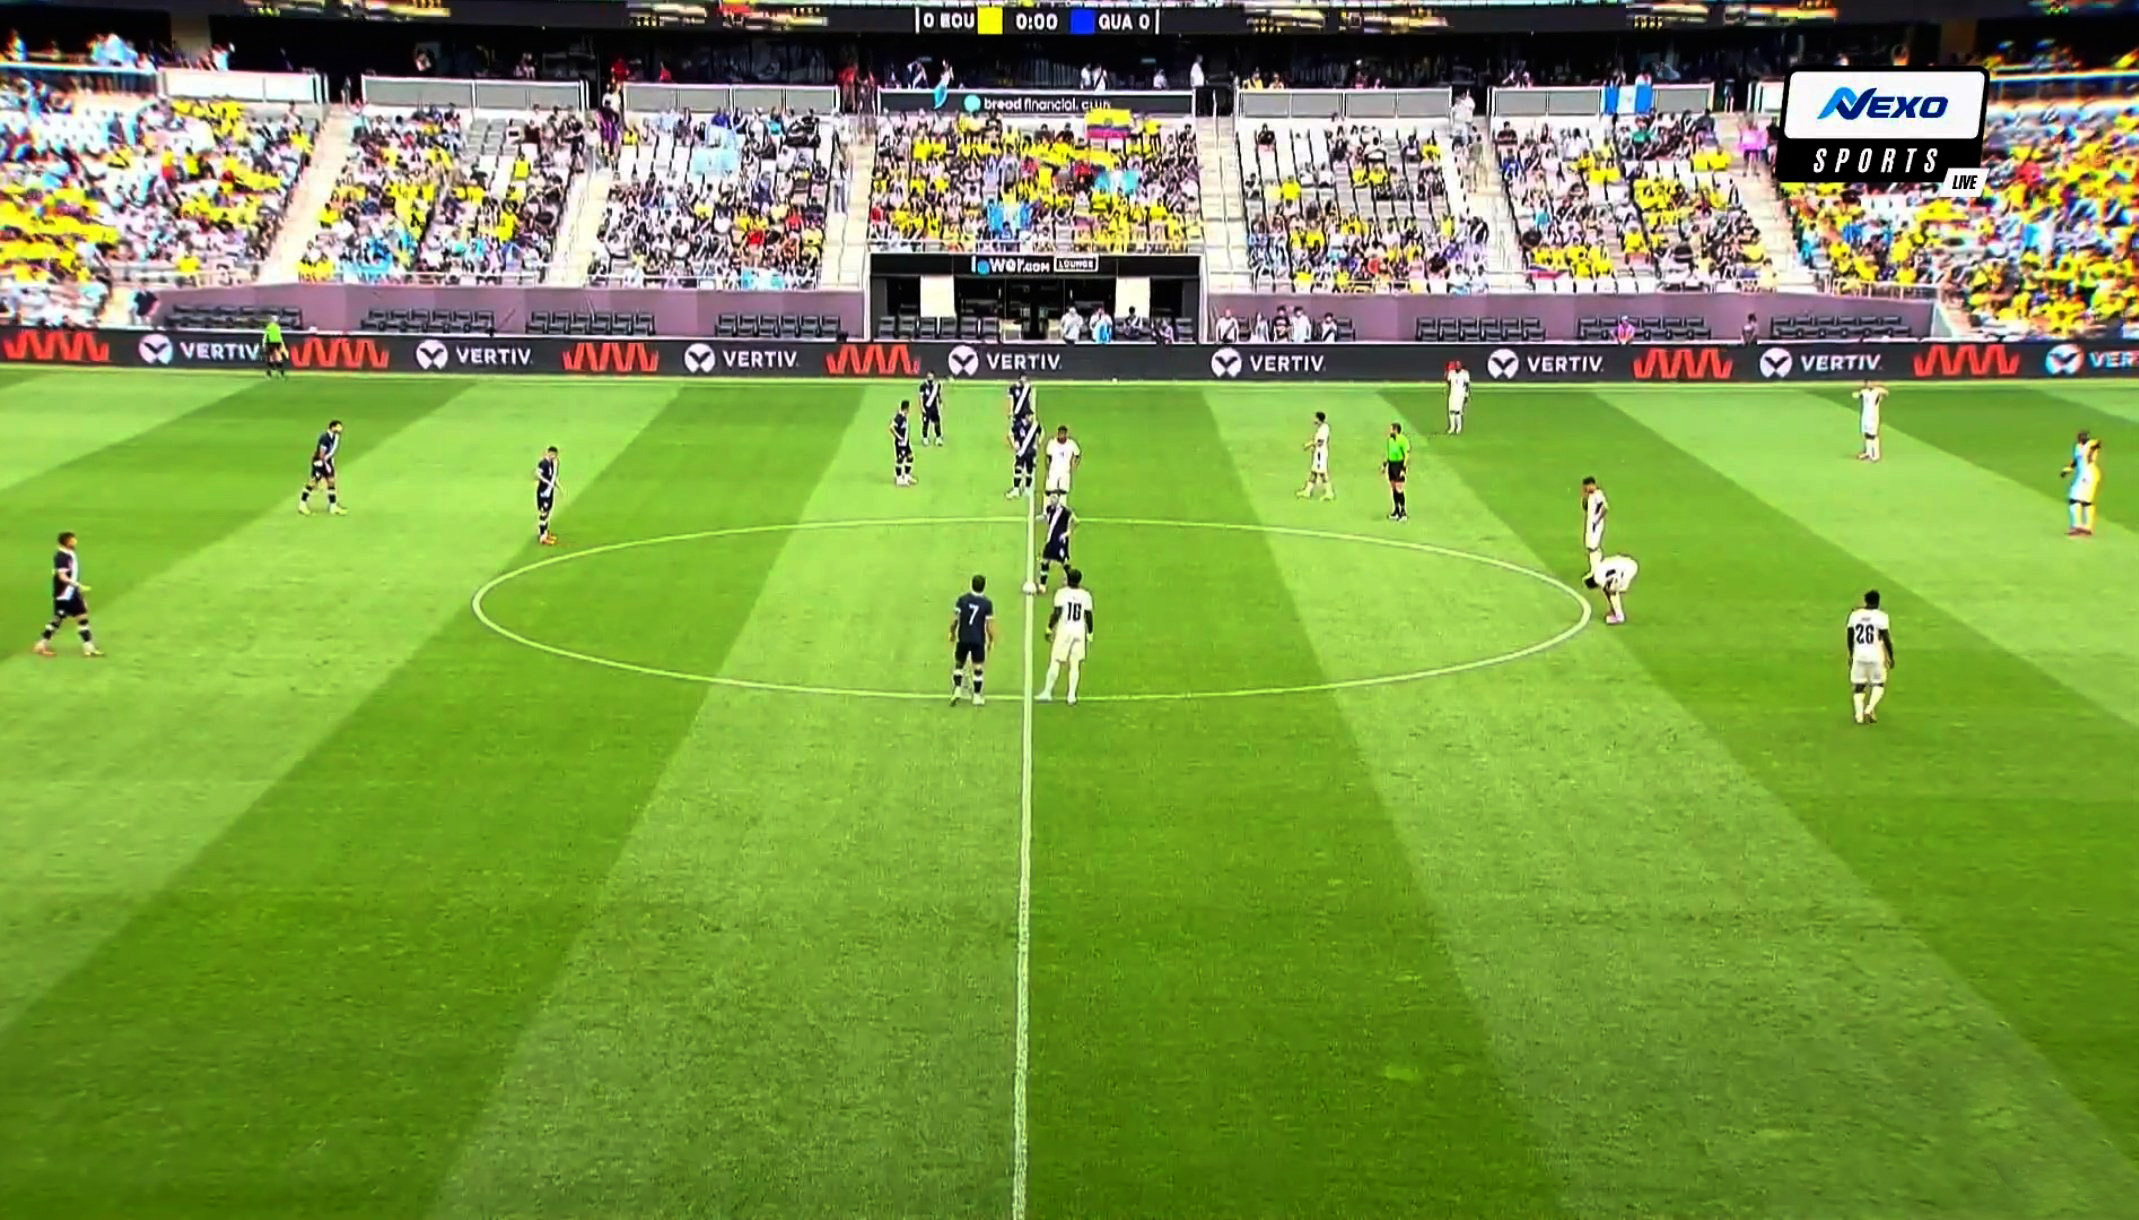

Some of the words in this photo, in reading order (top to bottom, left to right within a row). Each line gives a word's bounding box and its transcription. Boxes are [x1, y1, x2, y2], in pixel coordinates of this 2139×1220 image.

[923, 13, 935, 28] 0
[1015, 13, 1058, 30] 0:00
[1138, 13, 1151, 30] 0
[984, 97, 1022, 110] bread
[968, 602, 979, 626] 7
[1855, 623, 1875, 644] 26
